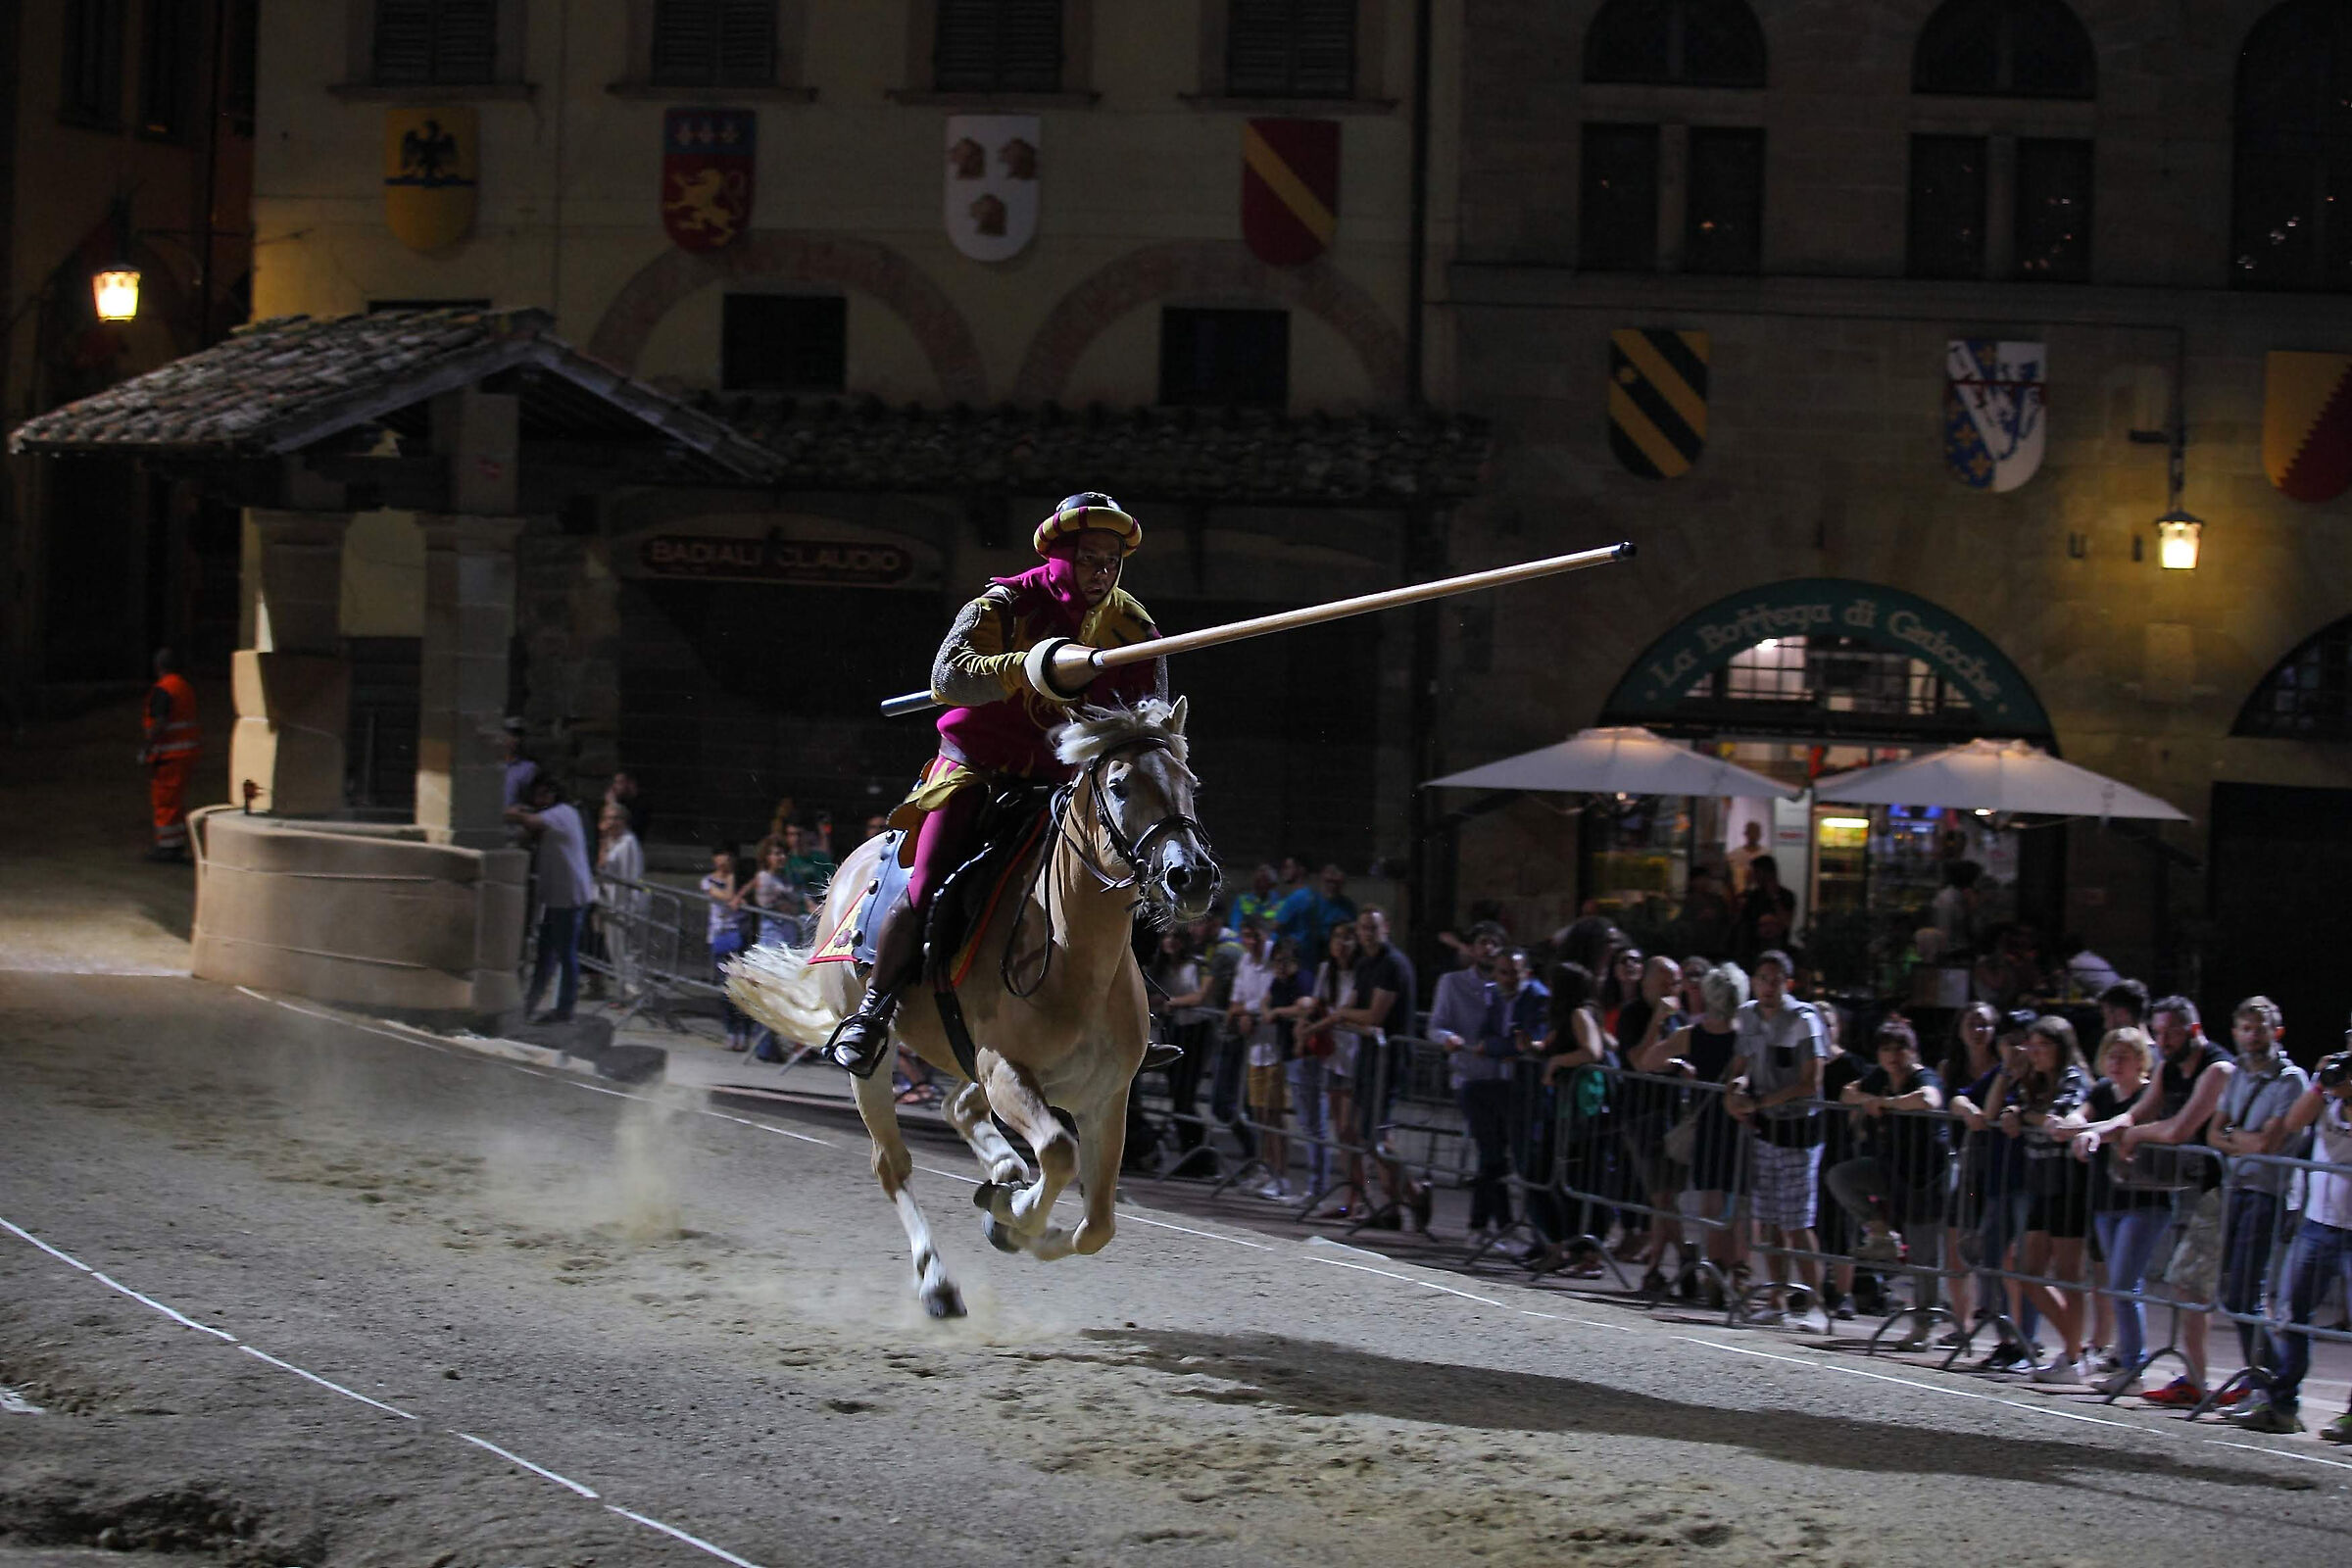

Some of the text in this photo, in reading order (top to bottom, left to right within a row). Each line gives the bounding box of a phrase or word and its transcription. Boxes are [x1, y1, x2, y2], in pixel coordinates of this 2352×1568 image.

[651, 540, 762, 566] BADIALI
[1649, 648, 1698, 684] La
[1696, 603, 1833, 652] Bottega
[1843, 599, 1879, 628] di
